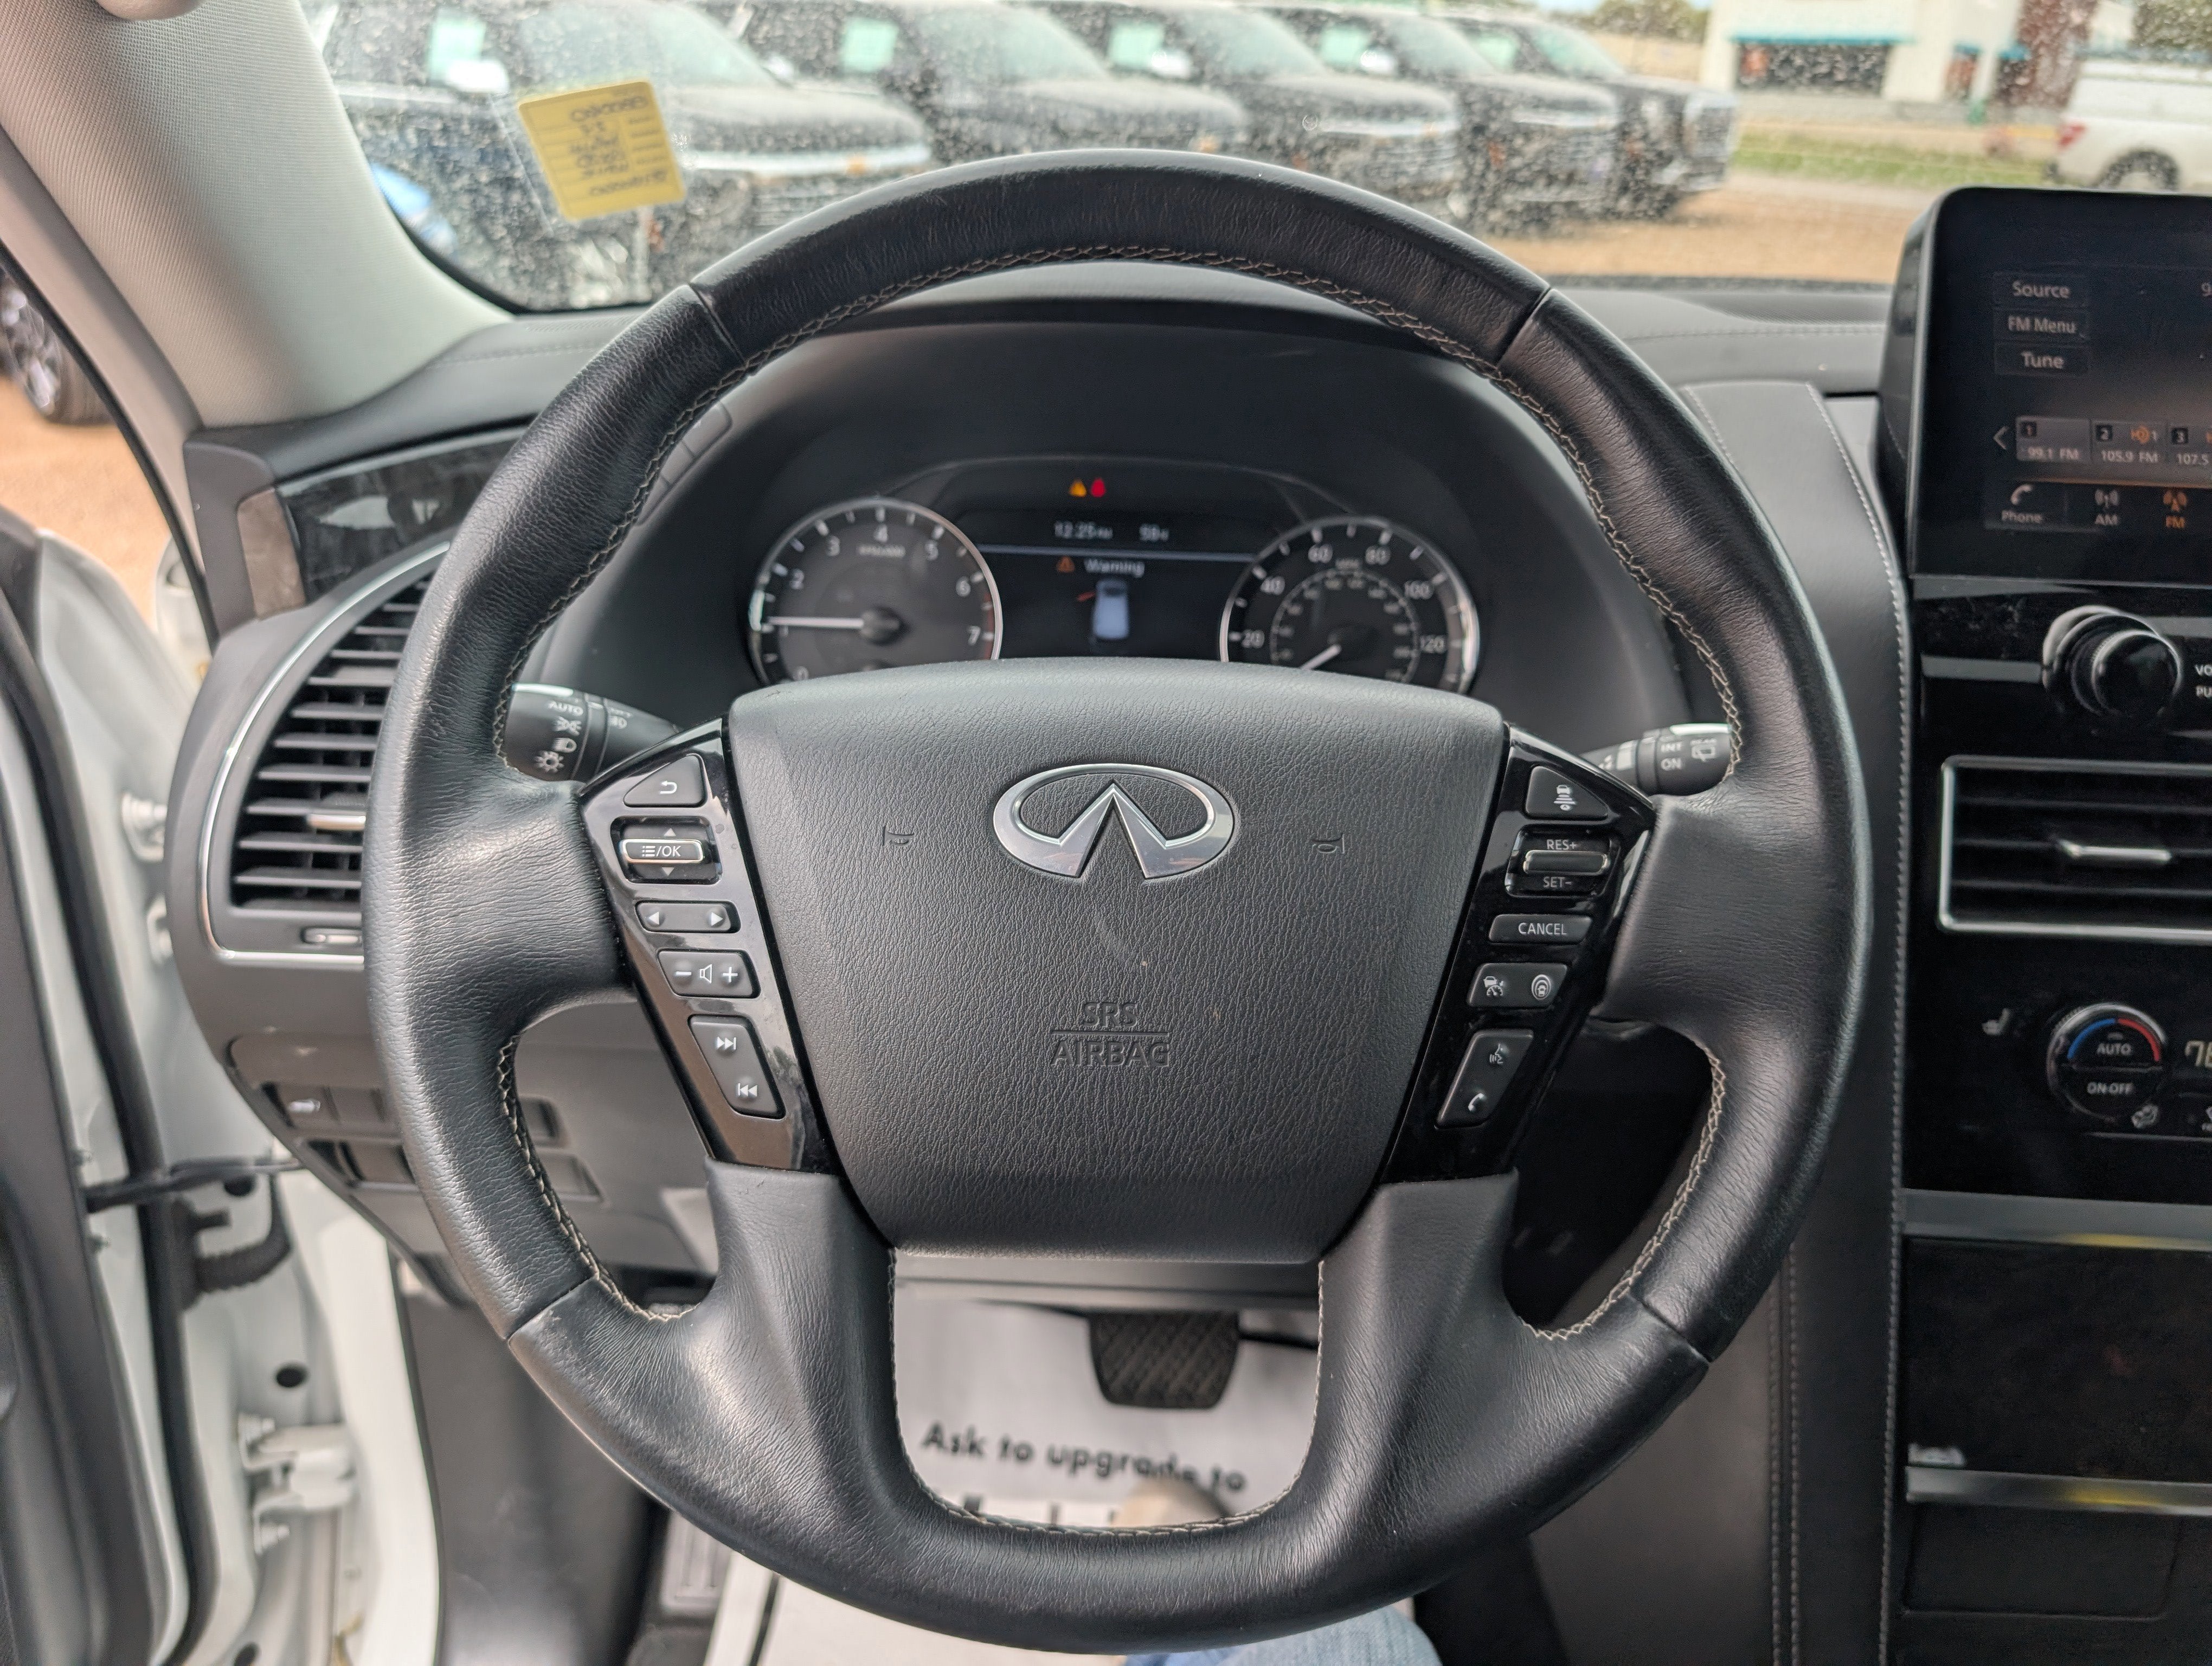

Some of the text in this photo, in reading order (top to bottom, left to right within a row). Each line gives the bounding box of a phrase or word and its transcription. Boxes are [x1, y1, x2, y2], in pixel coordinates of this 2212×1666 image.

[2012, 280, 2070, 299] Source
[2008, 315, 2076, 334] FM Menu
[2021, 351, 2065, 369] Tune
[2060, 448, 2080, 460] FM
[2139, 451, 2159, 464] FM
[2176, 452, 2209, 466] 107.5
[2001, 509, 2043, 524] Phone
[2094, 514, 2119, 526] AM
[2165, 516, 2186, 529] FM
[826, 535, 840, 556] 3
[924, 539, 938, 561] 5
[1308, 544, 1333, 563] 60
[1365, 545, 1391, 565] 80
[1085, 559, 1145, 578] Warning
[789, 568, 805, 589] 2
[955, 575, 972, 597] 6
[1260, 576, 1285, 595] 40
[1405, 580, 1433, 599] 100
[967, 625, 981, 646] 7
[1242, 630, 1265, 649] 20
[1420, 635, 1445, 653] 120
[548, 700, 584, 716] AUTO
[1546, 838, 1578, 851] RES+
[1518, 922, 1567, 936] CANCEL
[1084, 1003, 1138, 1028] SRS
[1051, 1040, 1170, 1067] AIRBAG
[2097, 1043, 2133, 1056] AUTO
[922, 1421, 986, 1458] Ask
[1000, 1434, 1034, 1463] to
[1210, 1464, 1247, 1492] to
